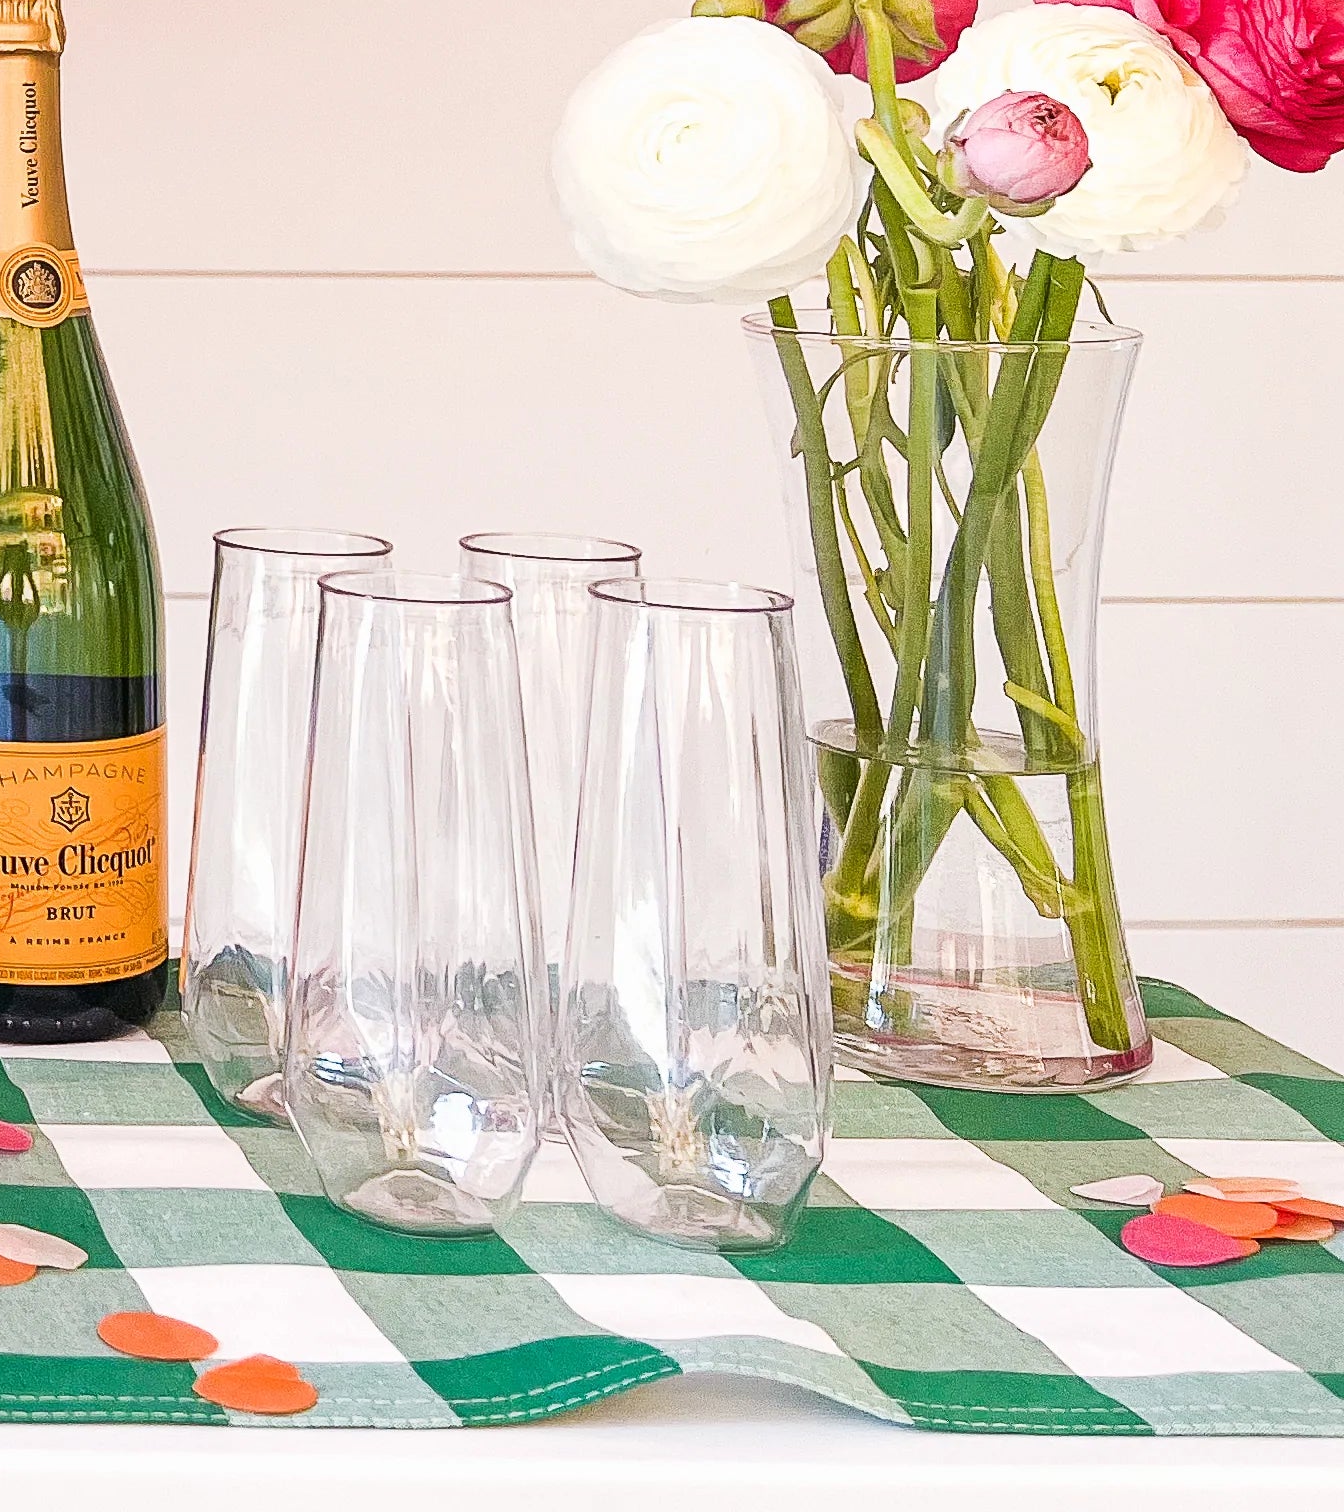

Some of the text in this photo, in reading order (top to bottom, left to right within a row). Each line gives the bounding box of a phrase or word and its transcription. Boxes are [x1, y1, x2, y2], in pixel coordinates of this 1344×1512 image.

[18, 82, 41, 209] Veuve Clicquot
[58, 836, 155, 878] Clicquot
[46, 904, 97, 921] BRUT
[79, 932, 126, 944] FRANCE
